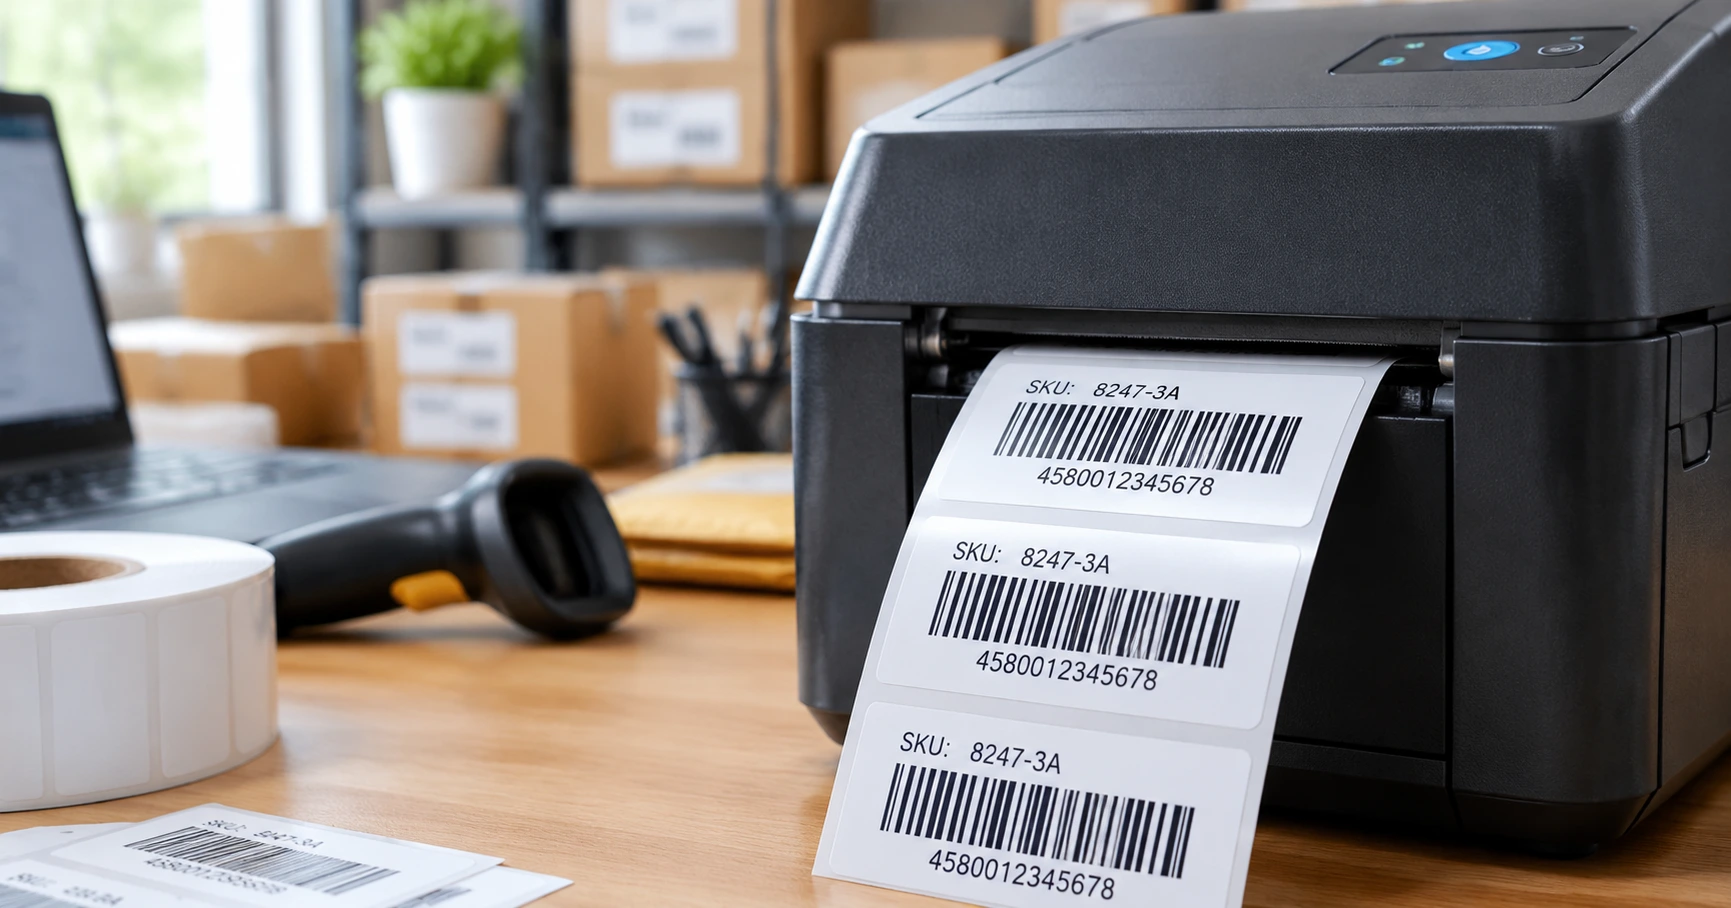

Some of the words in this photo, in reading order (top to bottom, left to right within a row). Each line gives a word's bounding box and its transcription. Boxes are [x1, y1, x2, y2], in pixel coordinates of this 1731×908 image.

[1025, 379, 1076, 396] SKU:
[1093, 382, 1180, 401] 8247-3A
[1037, 466, 1215, 496] 4580012345678
[952, 541, 1003, 565] SKU:
[1020, 547, 1110, 575] 8247-3A
[976, 650, 1159, 691] 4580012345678
[900, 731, 951, 757] SKU:
[970, 741, 1062, 775] 8247-3A
[928, 849, 1115, 900] 4580012345678
